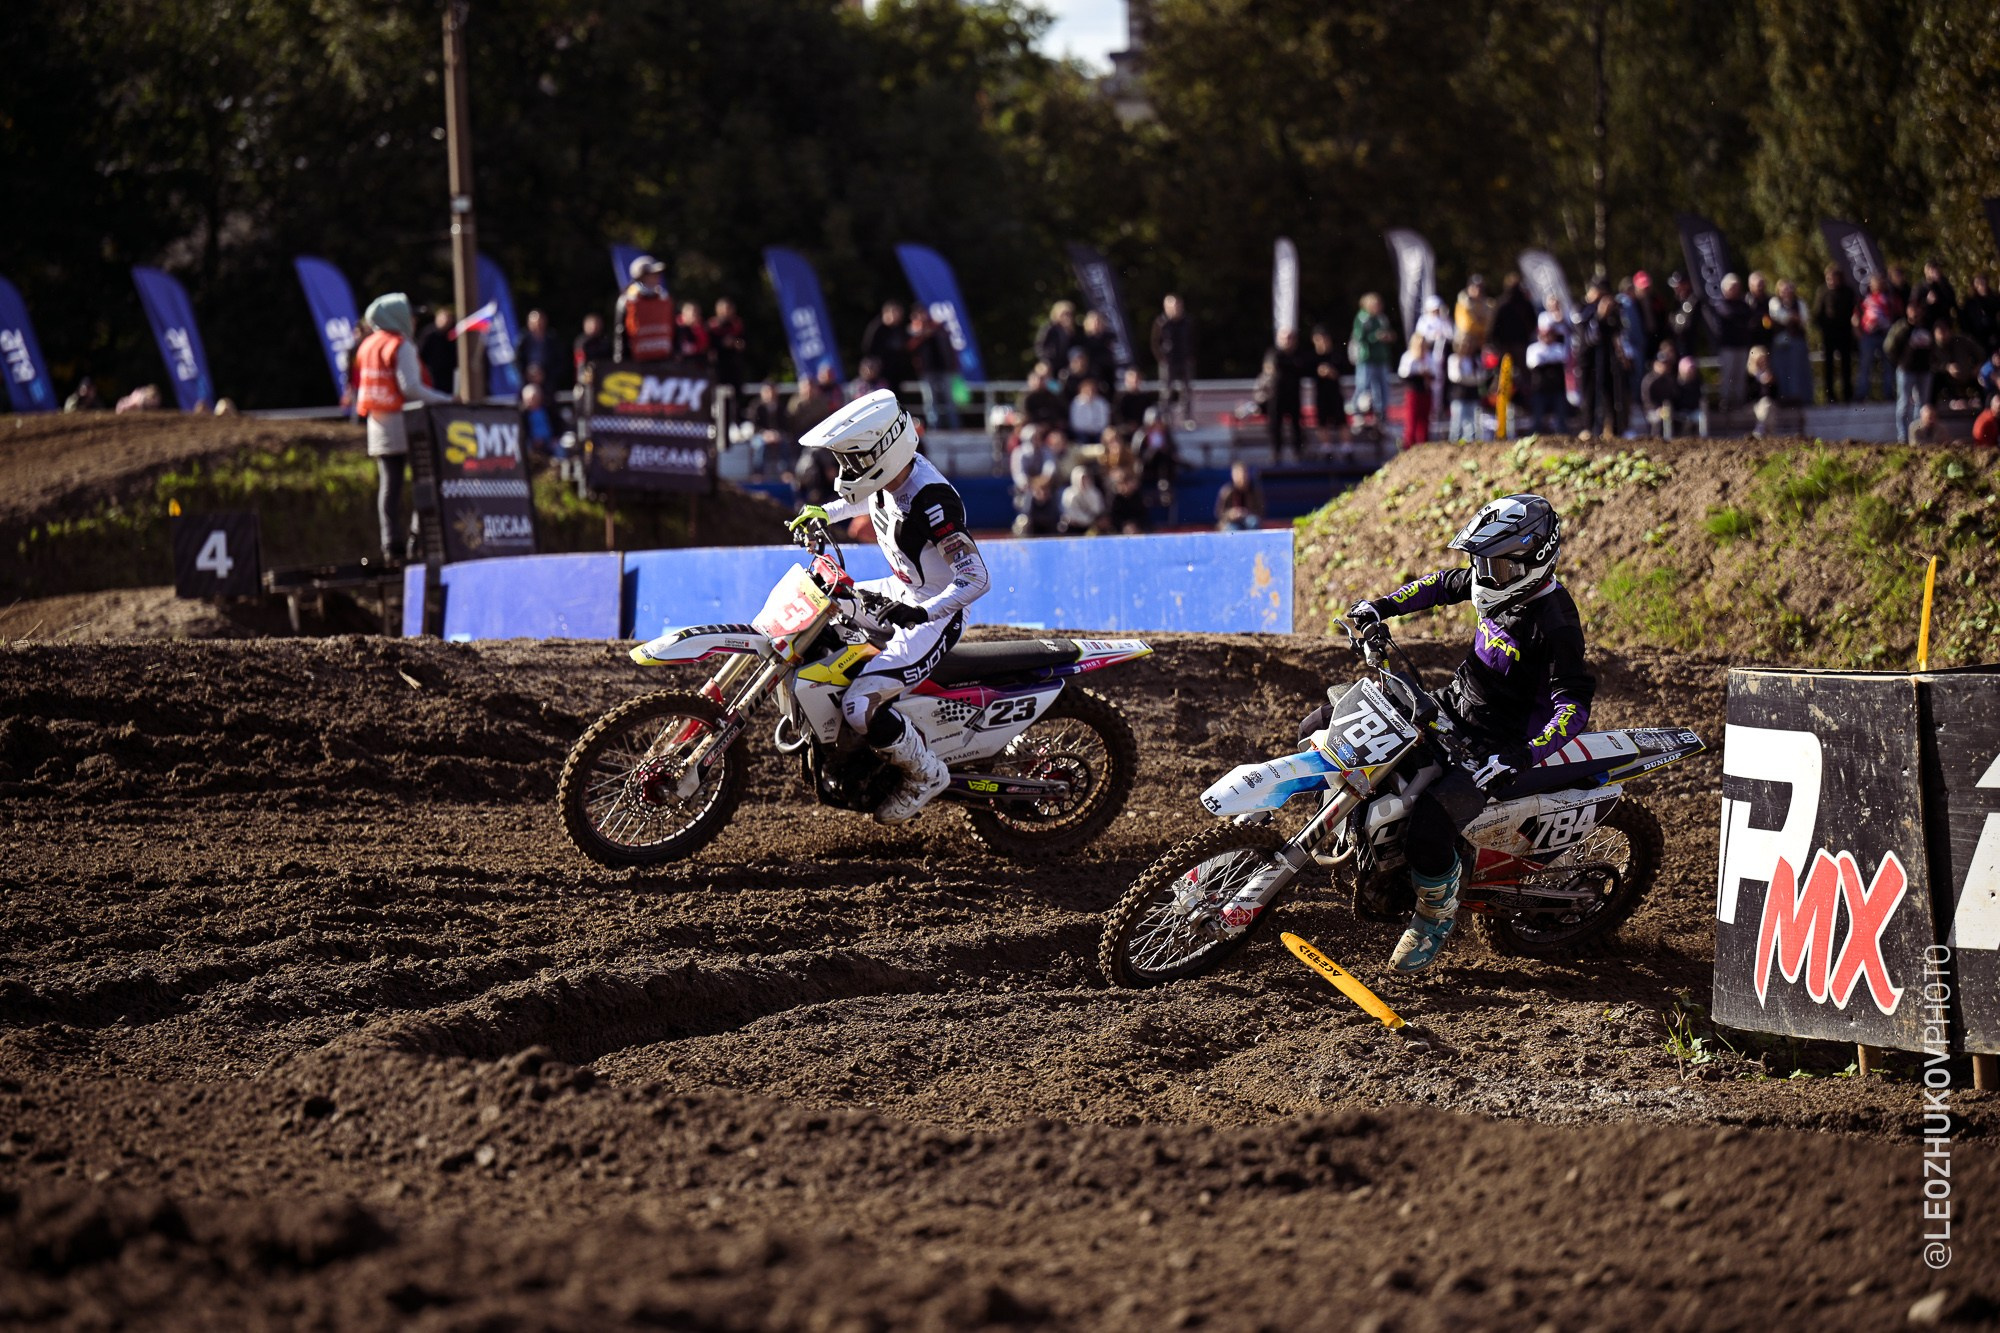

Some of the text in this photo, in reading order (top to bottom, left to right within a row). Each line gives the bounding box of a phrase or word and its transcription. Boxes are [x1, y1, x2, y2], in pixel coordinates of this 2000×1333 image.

[598, 372, 708, 412] SMX
[446, 420, 521, 464] SMX
[875, 408, 908, 460] 100%
[196, 530, 233, 578] 4
[903, 634, 947, 684] SHOT
[1081, 660, 1101, 671] SHOT
[988, 696, 1038, 726] 23
[1332, 699, 1403, 764] 784
[952, 750, 980, 760] ЛАДОГА
[1643, 752, 1682, 771] DUNLOP
[1531, 804, 1598, 850] 784
[1754, 847, 1908, 1016] MX
[1299, 944, 1343, 977] ACERBIS
